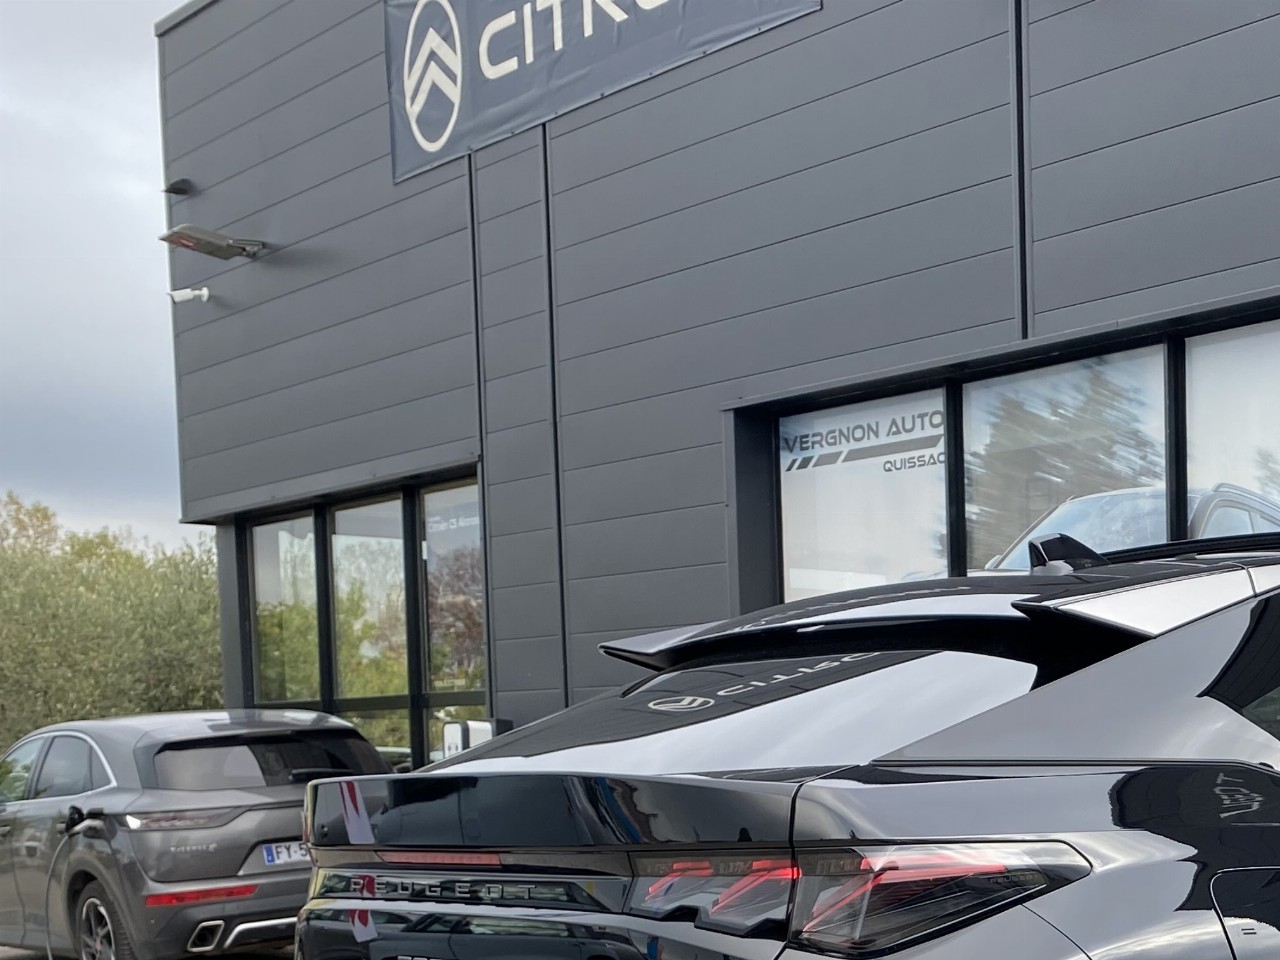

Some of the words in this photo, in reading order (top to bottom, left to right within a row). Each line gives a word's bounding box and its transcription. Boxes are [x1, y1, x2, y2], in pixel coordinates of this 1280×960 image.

[479, 0, 669, 79] CITR
[783, 420, 880, 454] VERGNON
[885, 409, 945, 437] AUTO
[883, 451, 946, 473] QUISSAC
[350, 878, 536, 900] PEUGEOT
